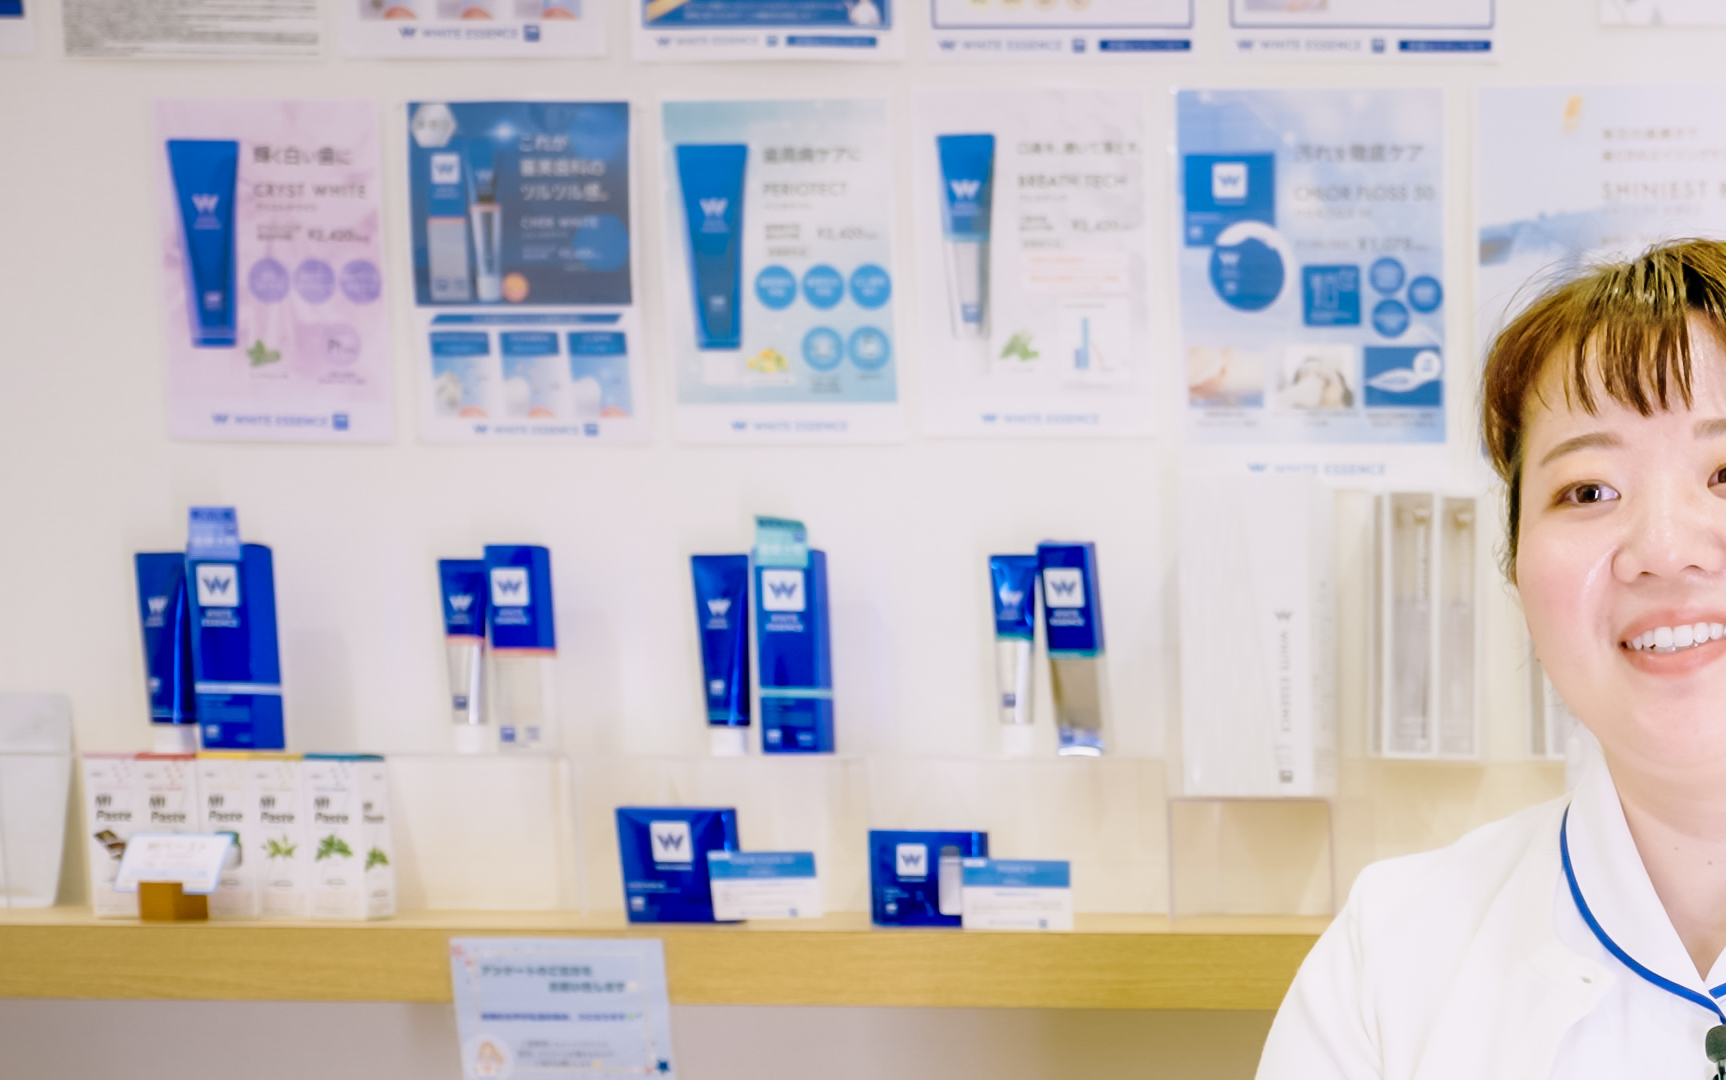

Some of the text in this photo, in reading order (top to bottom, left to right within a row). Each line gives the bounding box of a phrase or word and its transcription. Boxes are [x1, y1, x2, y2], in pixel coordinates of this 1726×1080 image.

[1017, 173, 1080, 189] BREATH
[252, 182, 367, 200] CRYST WHITE
[762, 182, 848, 197] PERIOTECT
[1355, 184, 1408, 202] FLOSS
[1601, 180, 1708, 200] SHINIEST
[95, 811, 133, 823] Paste
[150, 811, 187, 824] Paste
[208, 811, 244, 823] Paste
[259, 811, 296, 824] Paste
[314, 812, 350, 825] Paste
